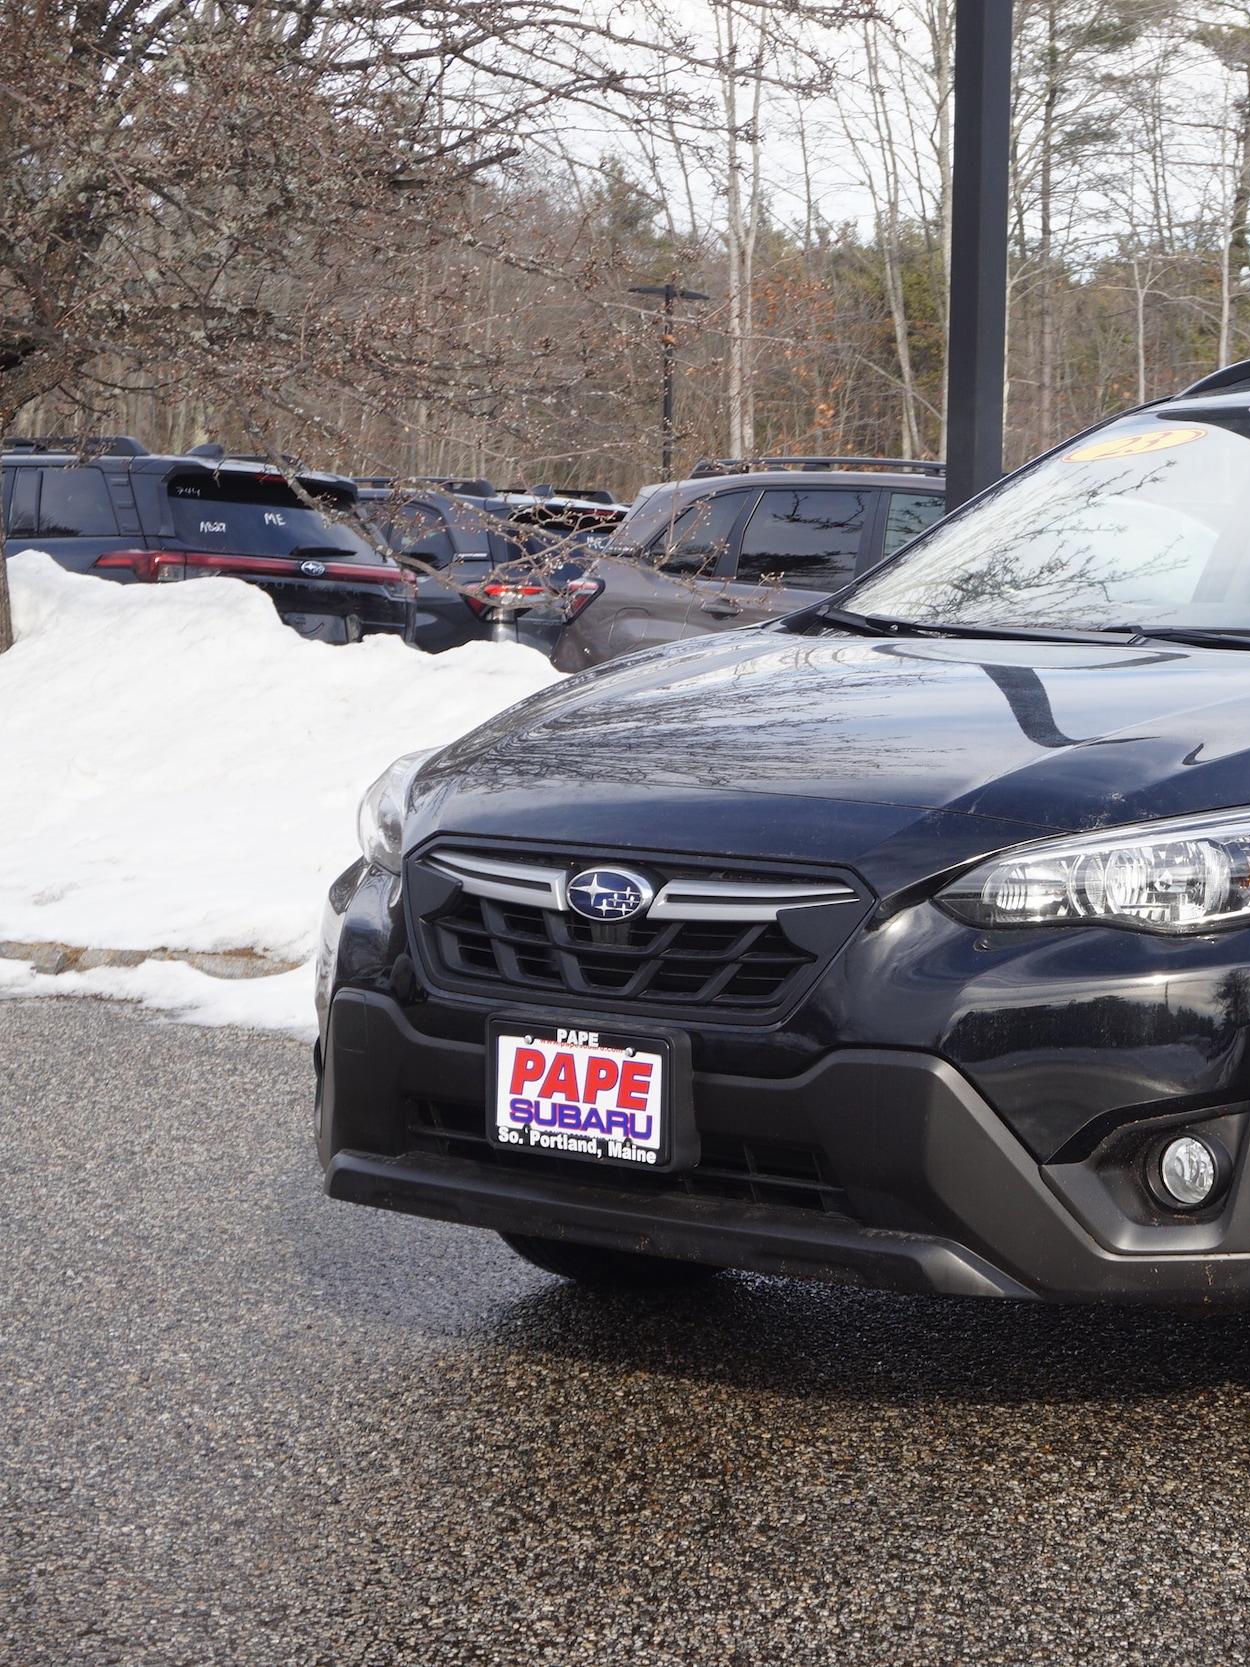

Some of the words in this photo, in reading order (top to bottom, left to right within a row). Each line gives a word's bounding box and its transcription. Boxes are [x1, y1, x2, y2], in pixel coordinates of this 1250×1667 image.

[264, 512, 287, 526] ME
[556, 1028, 600, 1047] PAPE
[508, 1047, 654, 1112] PAPE
[508, 1097, 653, 1141] SUBARU
[498, 1126, 524, 1145] So.
[529, 1129, 603, 1158] Portland,
[608, 1140, 657, 1165] Maine
